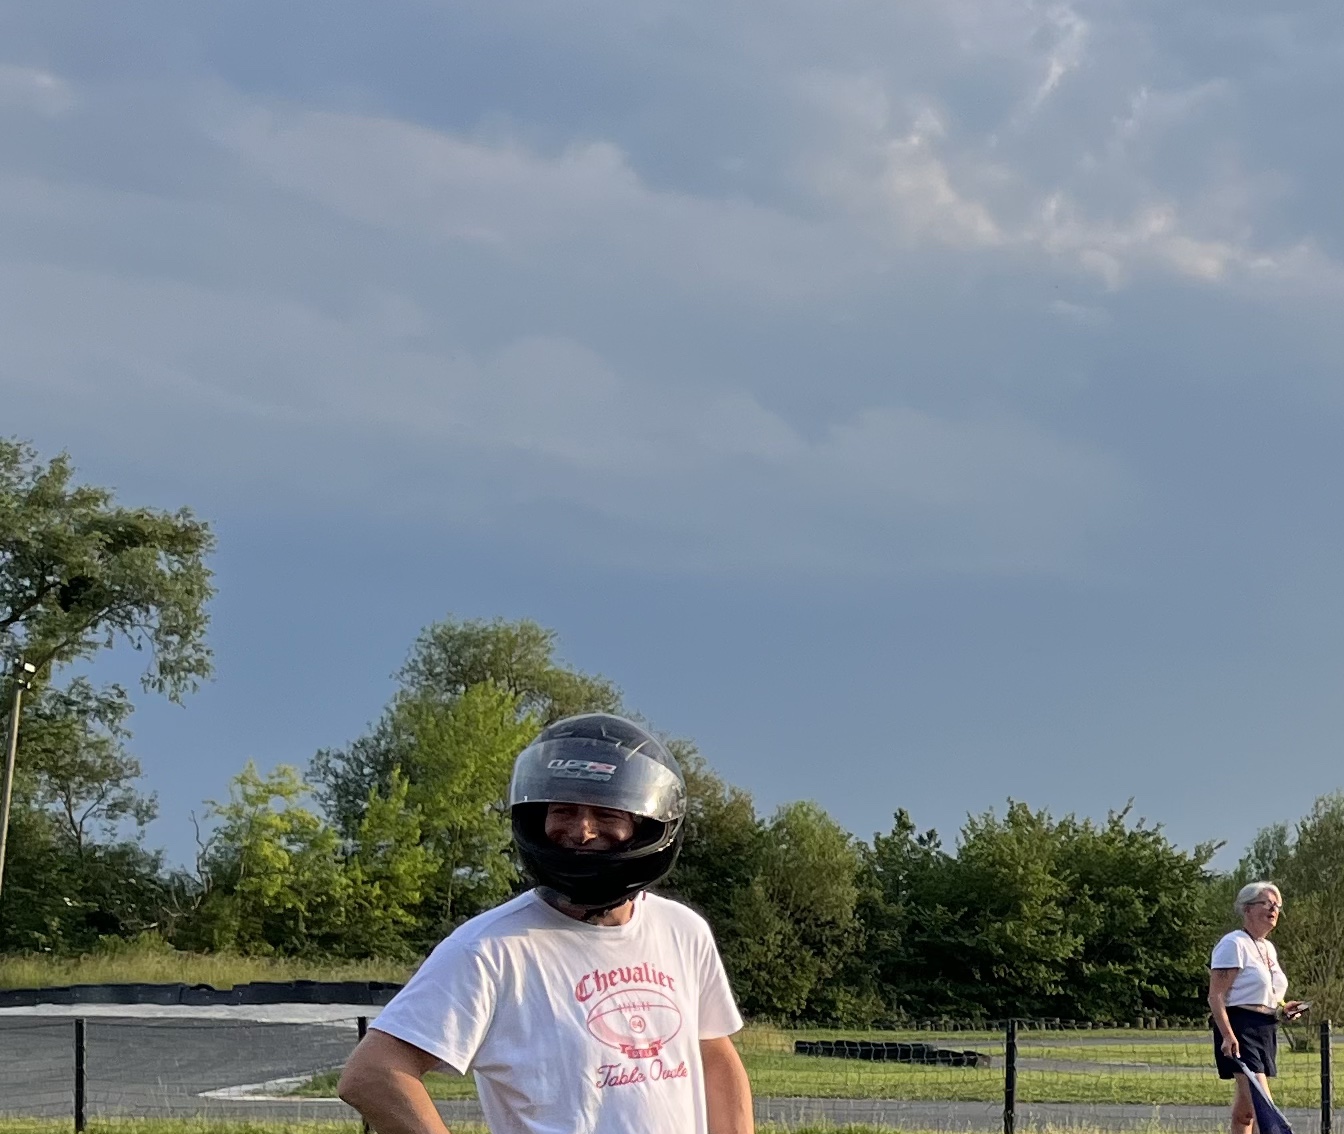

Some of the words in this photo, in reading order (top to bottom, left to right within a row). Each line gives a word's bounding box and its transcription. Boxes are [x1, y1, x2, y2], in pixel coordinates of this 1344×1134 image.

[575, 962, 676, 1002] Chevalier
[596, 1063, 647, 1089] Table
[650, 1059, 688, 1081] Ovale
